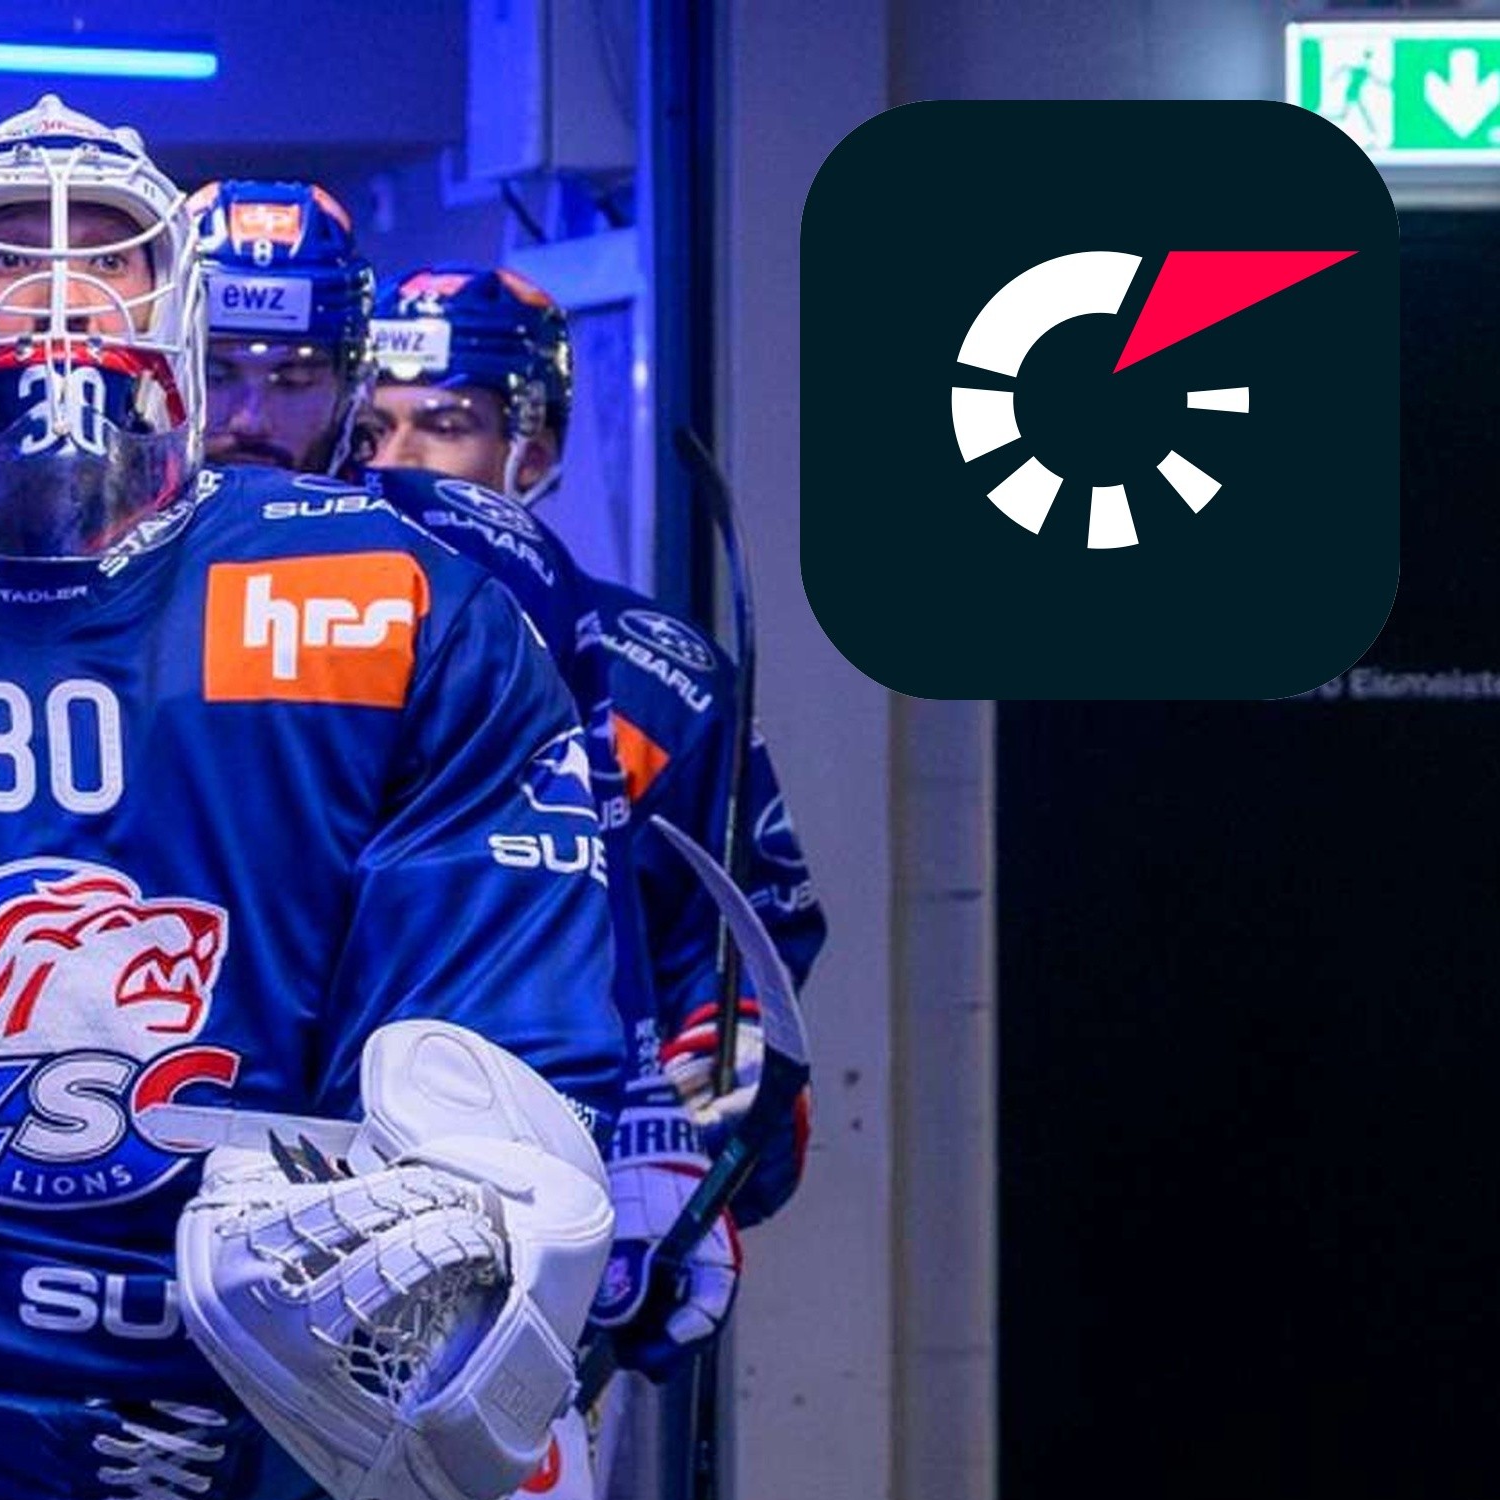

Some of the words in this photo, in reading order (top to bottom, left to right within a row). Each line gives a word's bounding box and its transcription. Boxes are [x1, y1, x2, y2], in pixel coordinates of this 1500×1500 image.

[222, 283, 286, 311] ewz
[18, 363, 108, 456] 30
[242, 573, 416, 681] hrs
[10, 1163, 133, 1196] LIONS
